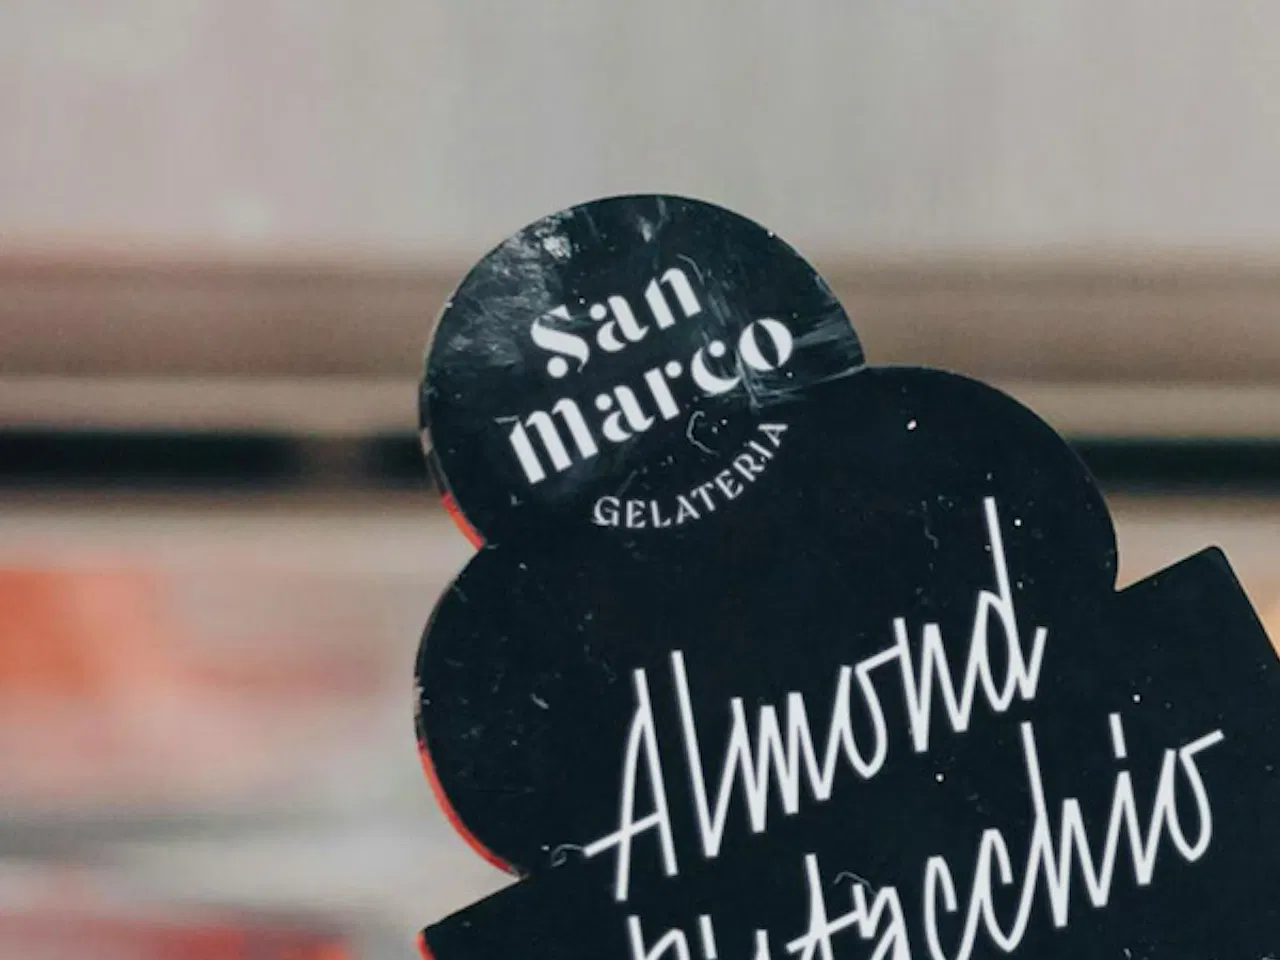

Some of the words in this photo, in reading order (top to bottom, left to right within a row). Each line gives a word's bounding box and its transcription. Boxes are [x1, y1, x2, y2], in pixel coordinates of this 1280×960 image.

[529, 266, 702, 379] San
[592, 422, 789, 529] GELATERIA
[583, 496, 1048, 901] Almond
